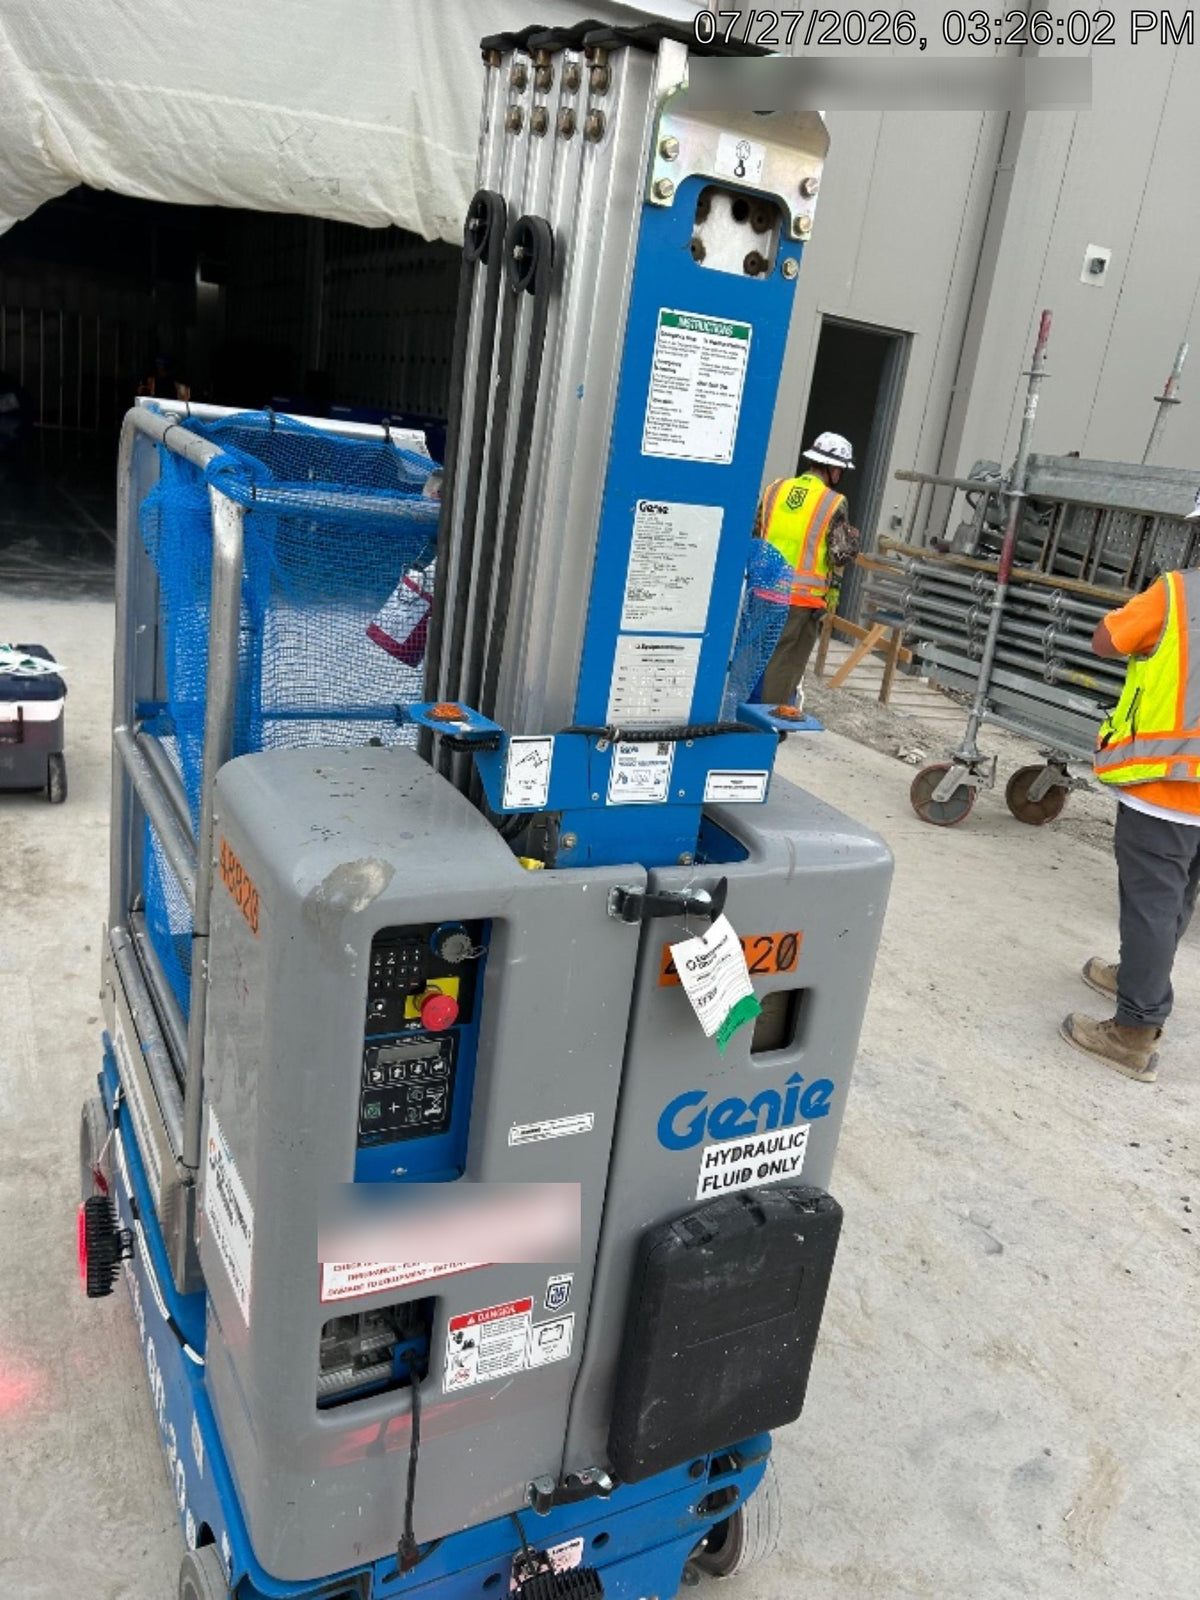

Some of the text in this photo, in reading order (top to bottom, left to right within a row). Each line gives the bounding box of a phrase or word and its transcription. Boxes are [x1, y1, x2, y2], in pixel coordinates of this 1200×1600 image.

[678, 315, 734, 336] INSTRUCTIONS
[657, 1072, 835, 1150] Genie
[705, 1130, 806, 1169] HYDRAULIC
[702, 1155, 801, 1193] FLUID ONLY
[477, 1304, 516, 1322] DANGER
